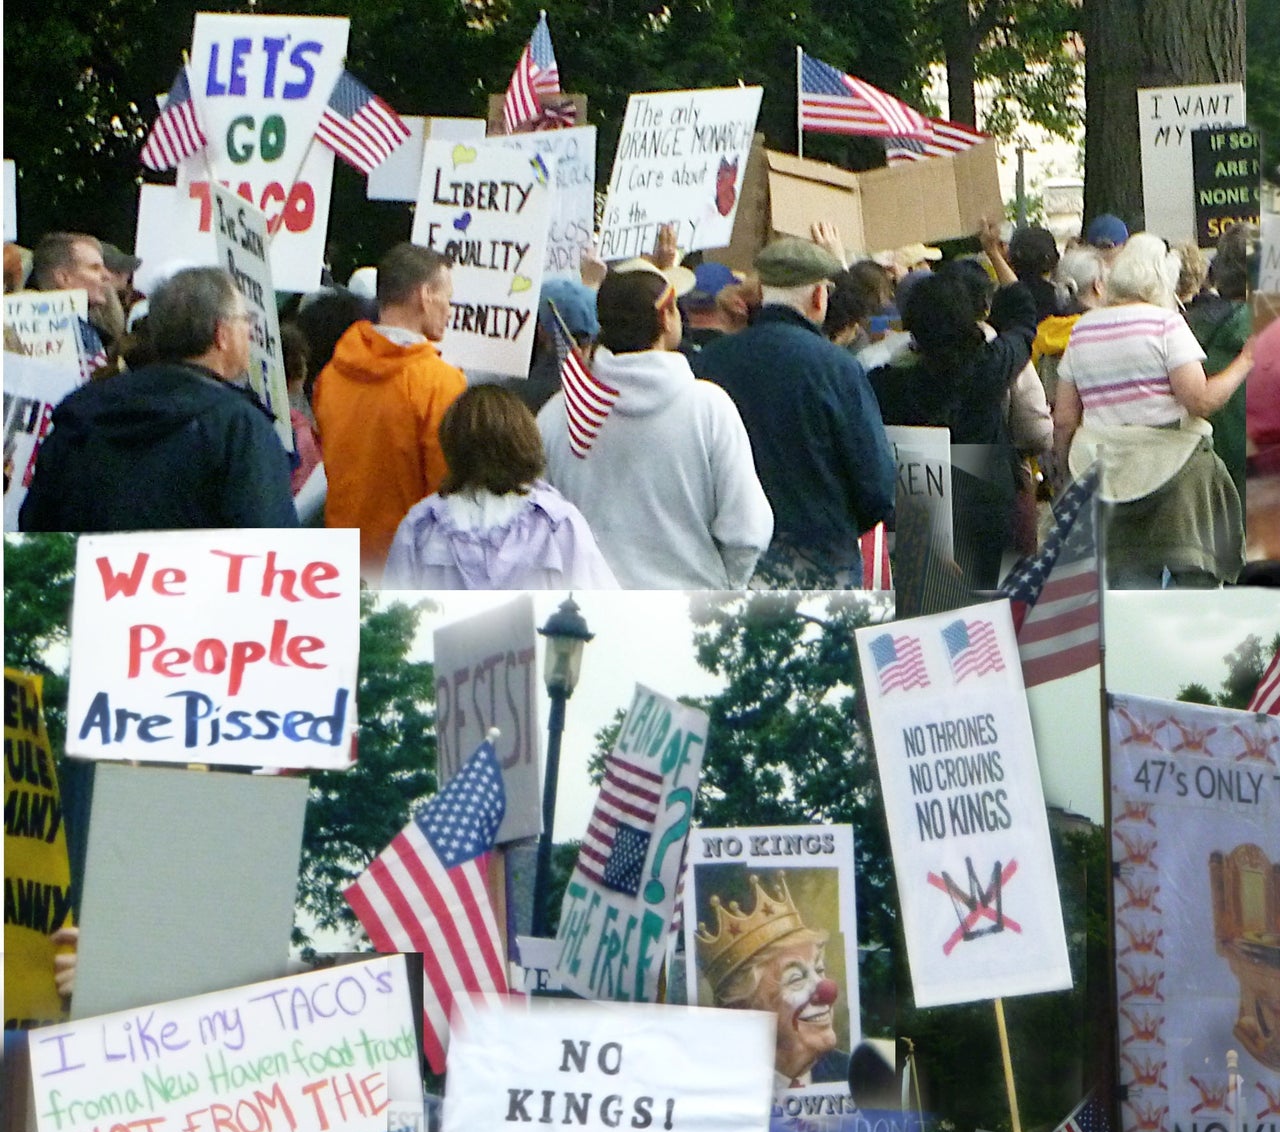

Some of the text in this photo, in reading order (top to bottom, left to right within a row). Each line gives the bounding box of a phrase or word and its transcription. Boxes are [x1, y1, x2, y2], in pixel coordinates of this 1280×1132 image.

[634, 100, 700, 126] The only
[1151, 94, 1235, 121] I WANT
[226, 114, 286, 165] GO
[620, 120, 751, 157] ORANGE MONARCH
[1154, 126, 1190, 147] MY
[96, 549, 341, 602] We The
[128, 619, 328, 697] People
[79, 688, 350, 748] Are Pissed
[904, 713, 998, 760] NO THRONES
[910, 752, 1004, 796] NO CROWNS
[1195, 766, 1262, 804] ONLY
[915, 788, 1012, 842] NO KINGS
[559, 1038, 624, 1075] NO
[504, 1088, 675, 1131] KINGS!
